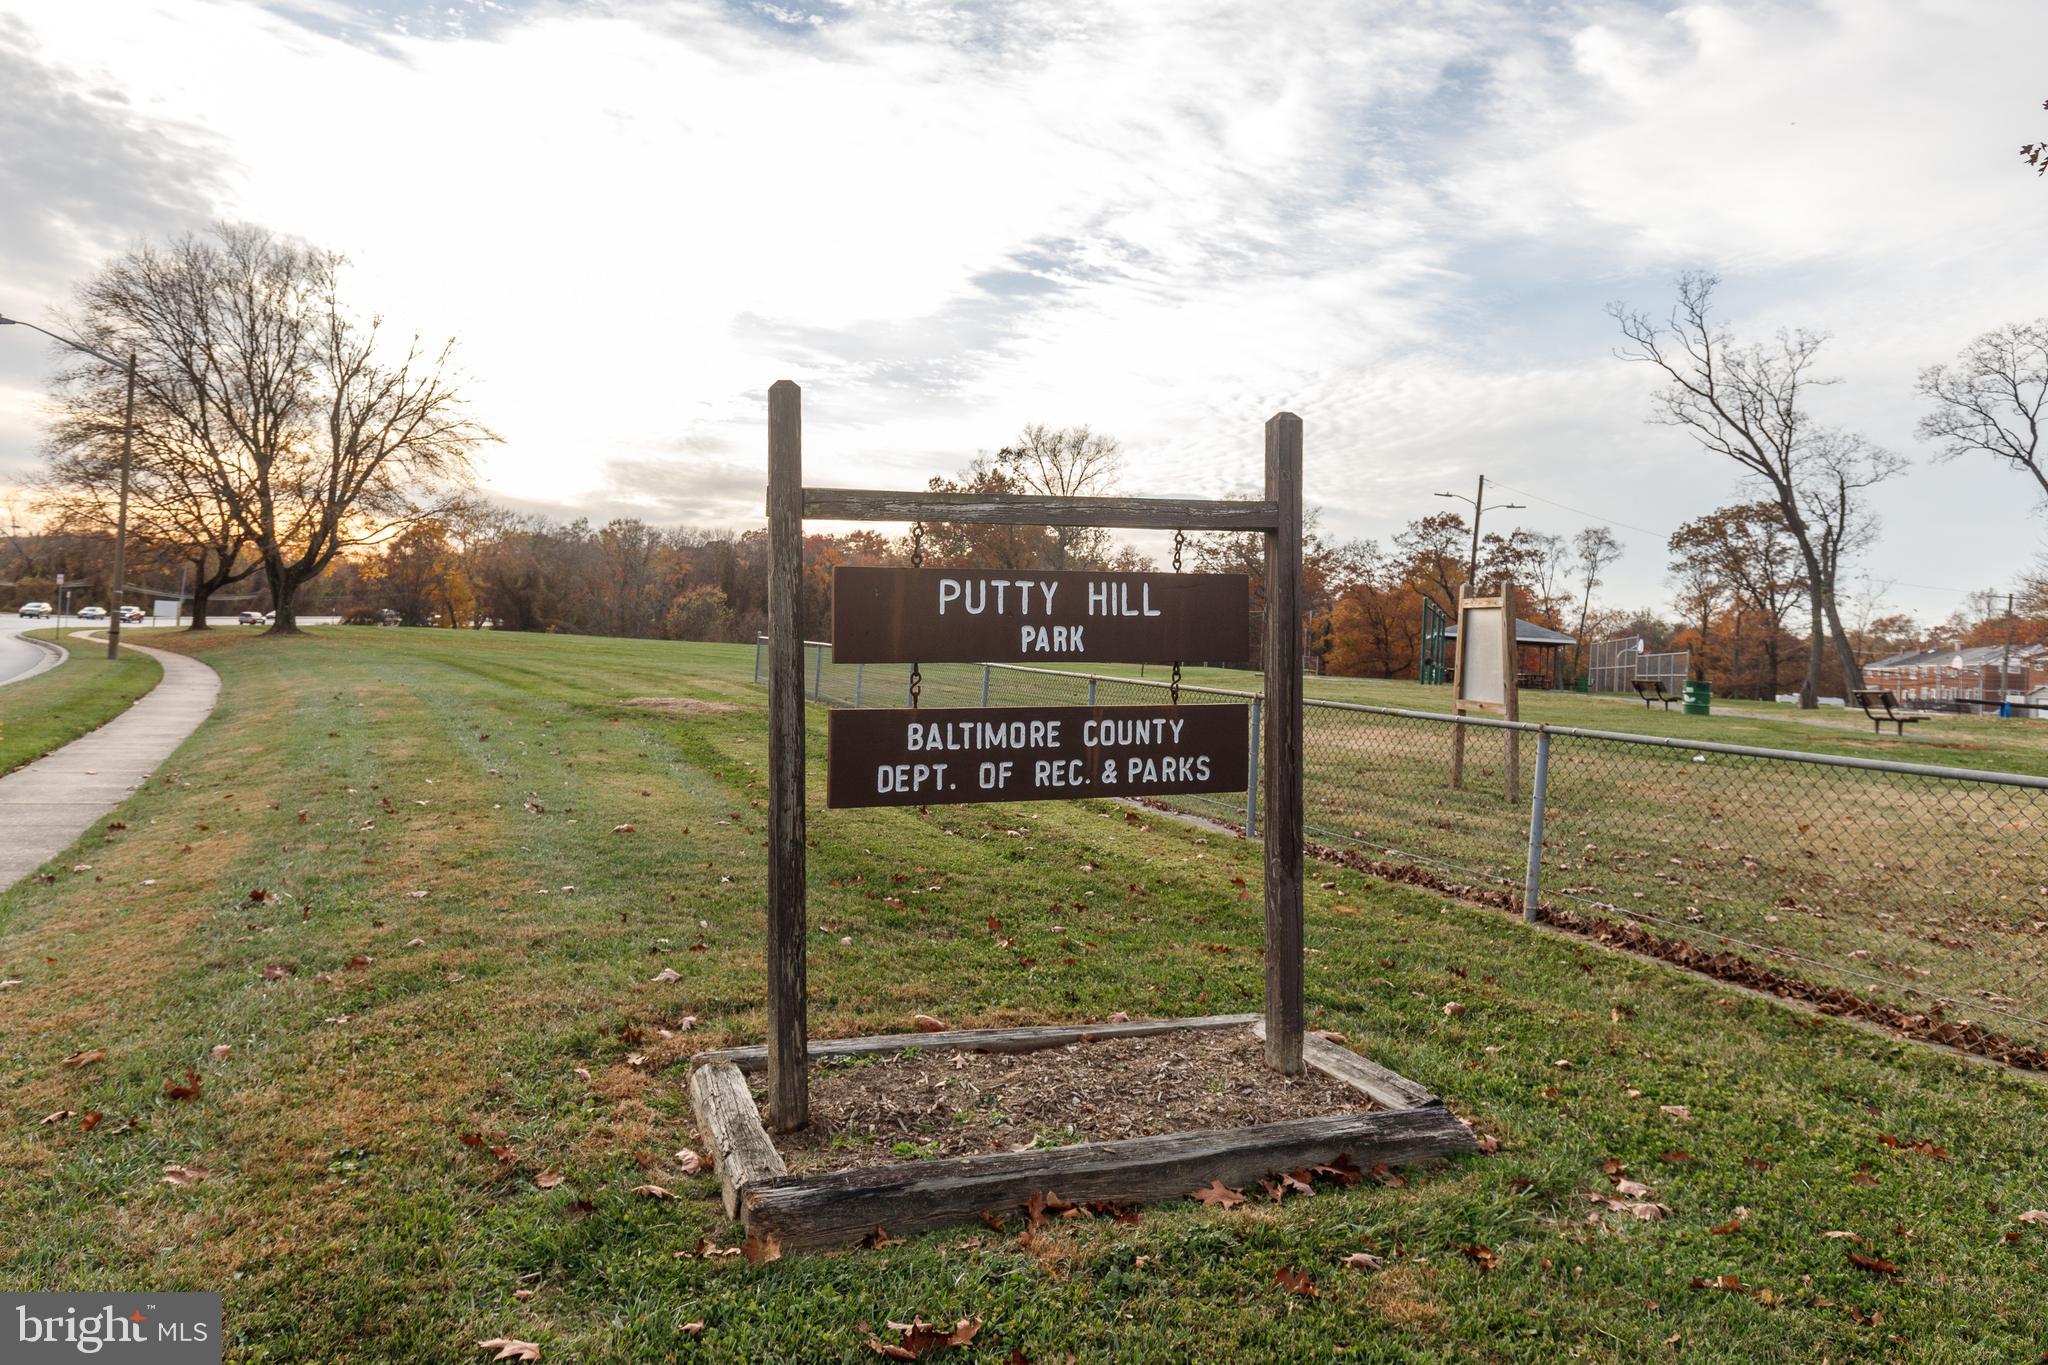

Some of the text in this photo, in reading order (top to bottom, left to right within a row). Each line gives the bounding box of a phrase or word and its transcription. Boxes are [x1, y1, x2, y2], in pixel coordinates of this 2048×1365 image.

[939, 578, 1161, 617] PUTTY HILL
[1021, 624, 1085, 653] PARK
[907, 718, 1184, 751] BALTIMORE COUNTY
[877, 756, 1210, 794] DEPT. OF REC. & PARKS
